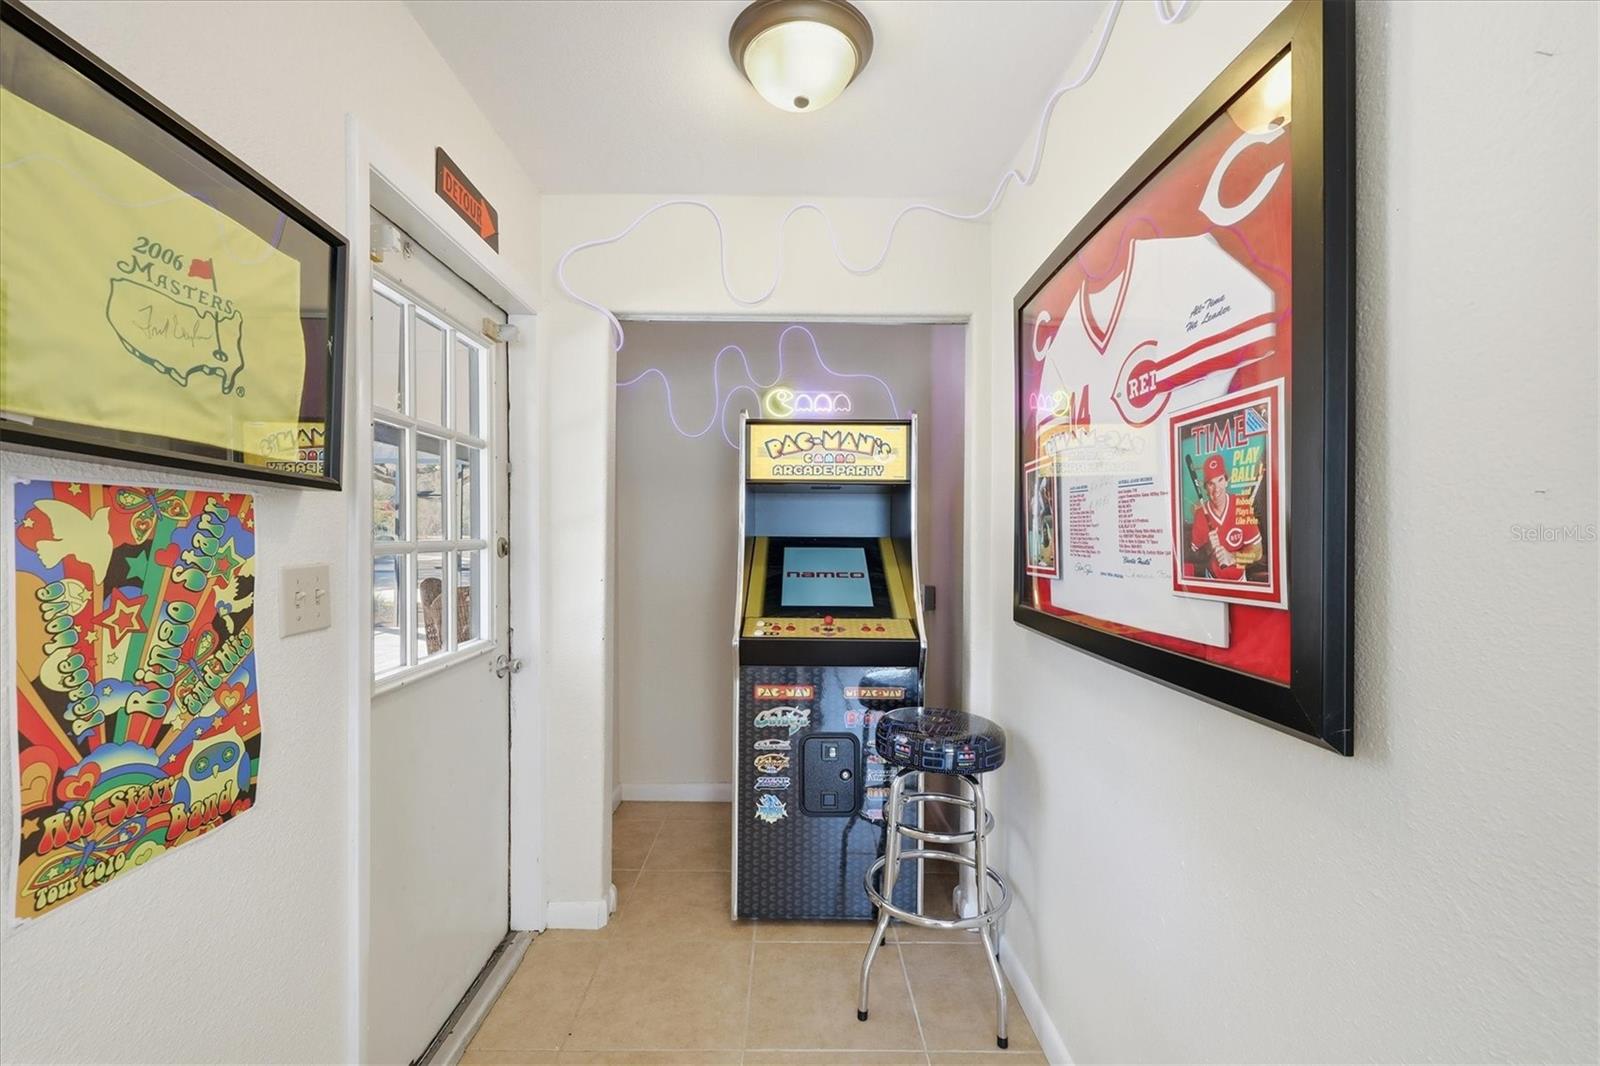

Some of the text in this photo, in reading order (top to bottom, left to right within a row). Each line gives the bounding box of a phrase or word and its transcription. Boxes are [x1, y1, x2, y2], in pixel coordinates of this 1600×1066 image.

[445, 170, 482, 224] DETOUR
[132, 236, 184, 272] 2006
[1200, 304, 1231, 325] Leader
[1191, 415, 1248, 456] TIME
[772, 464, 885, 476] ARCADE PARTY
[1232, 446, 1261, 466] PLAY
[786, 571, 865, 579] namco
[125, 496, 230, 718] Ringo Starr
[35, 580, 105, 736] Peace Love
[758, 687, 811, 697] PAC-MAN
[860, 689, 902, 697] PAC-MAN
[37, 776, 233, 855] All-Starr Band
[35, 852, 127, 911] Tour 2010
